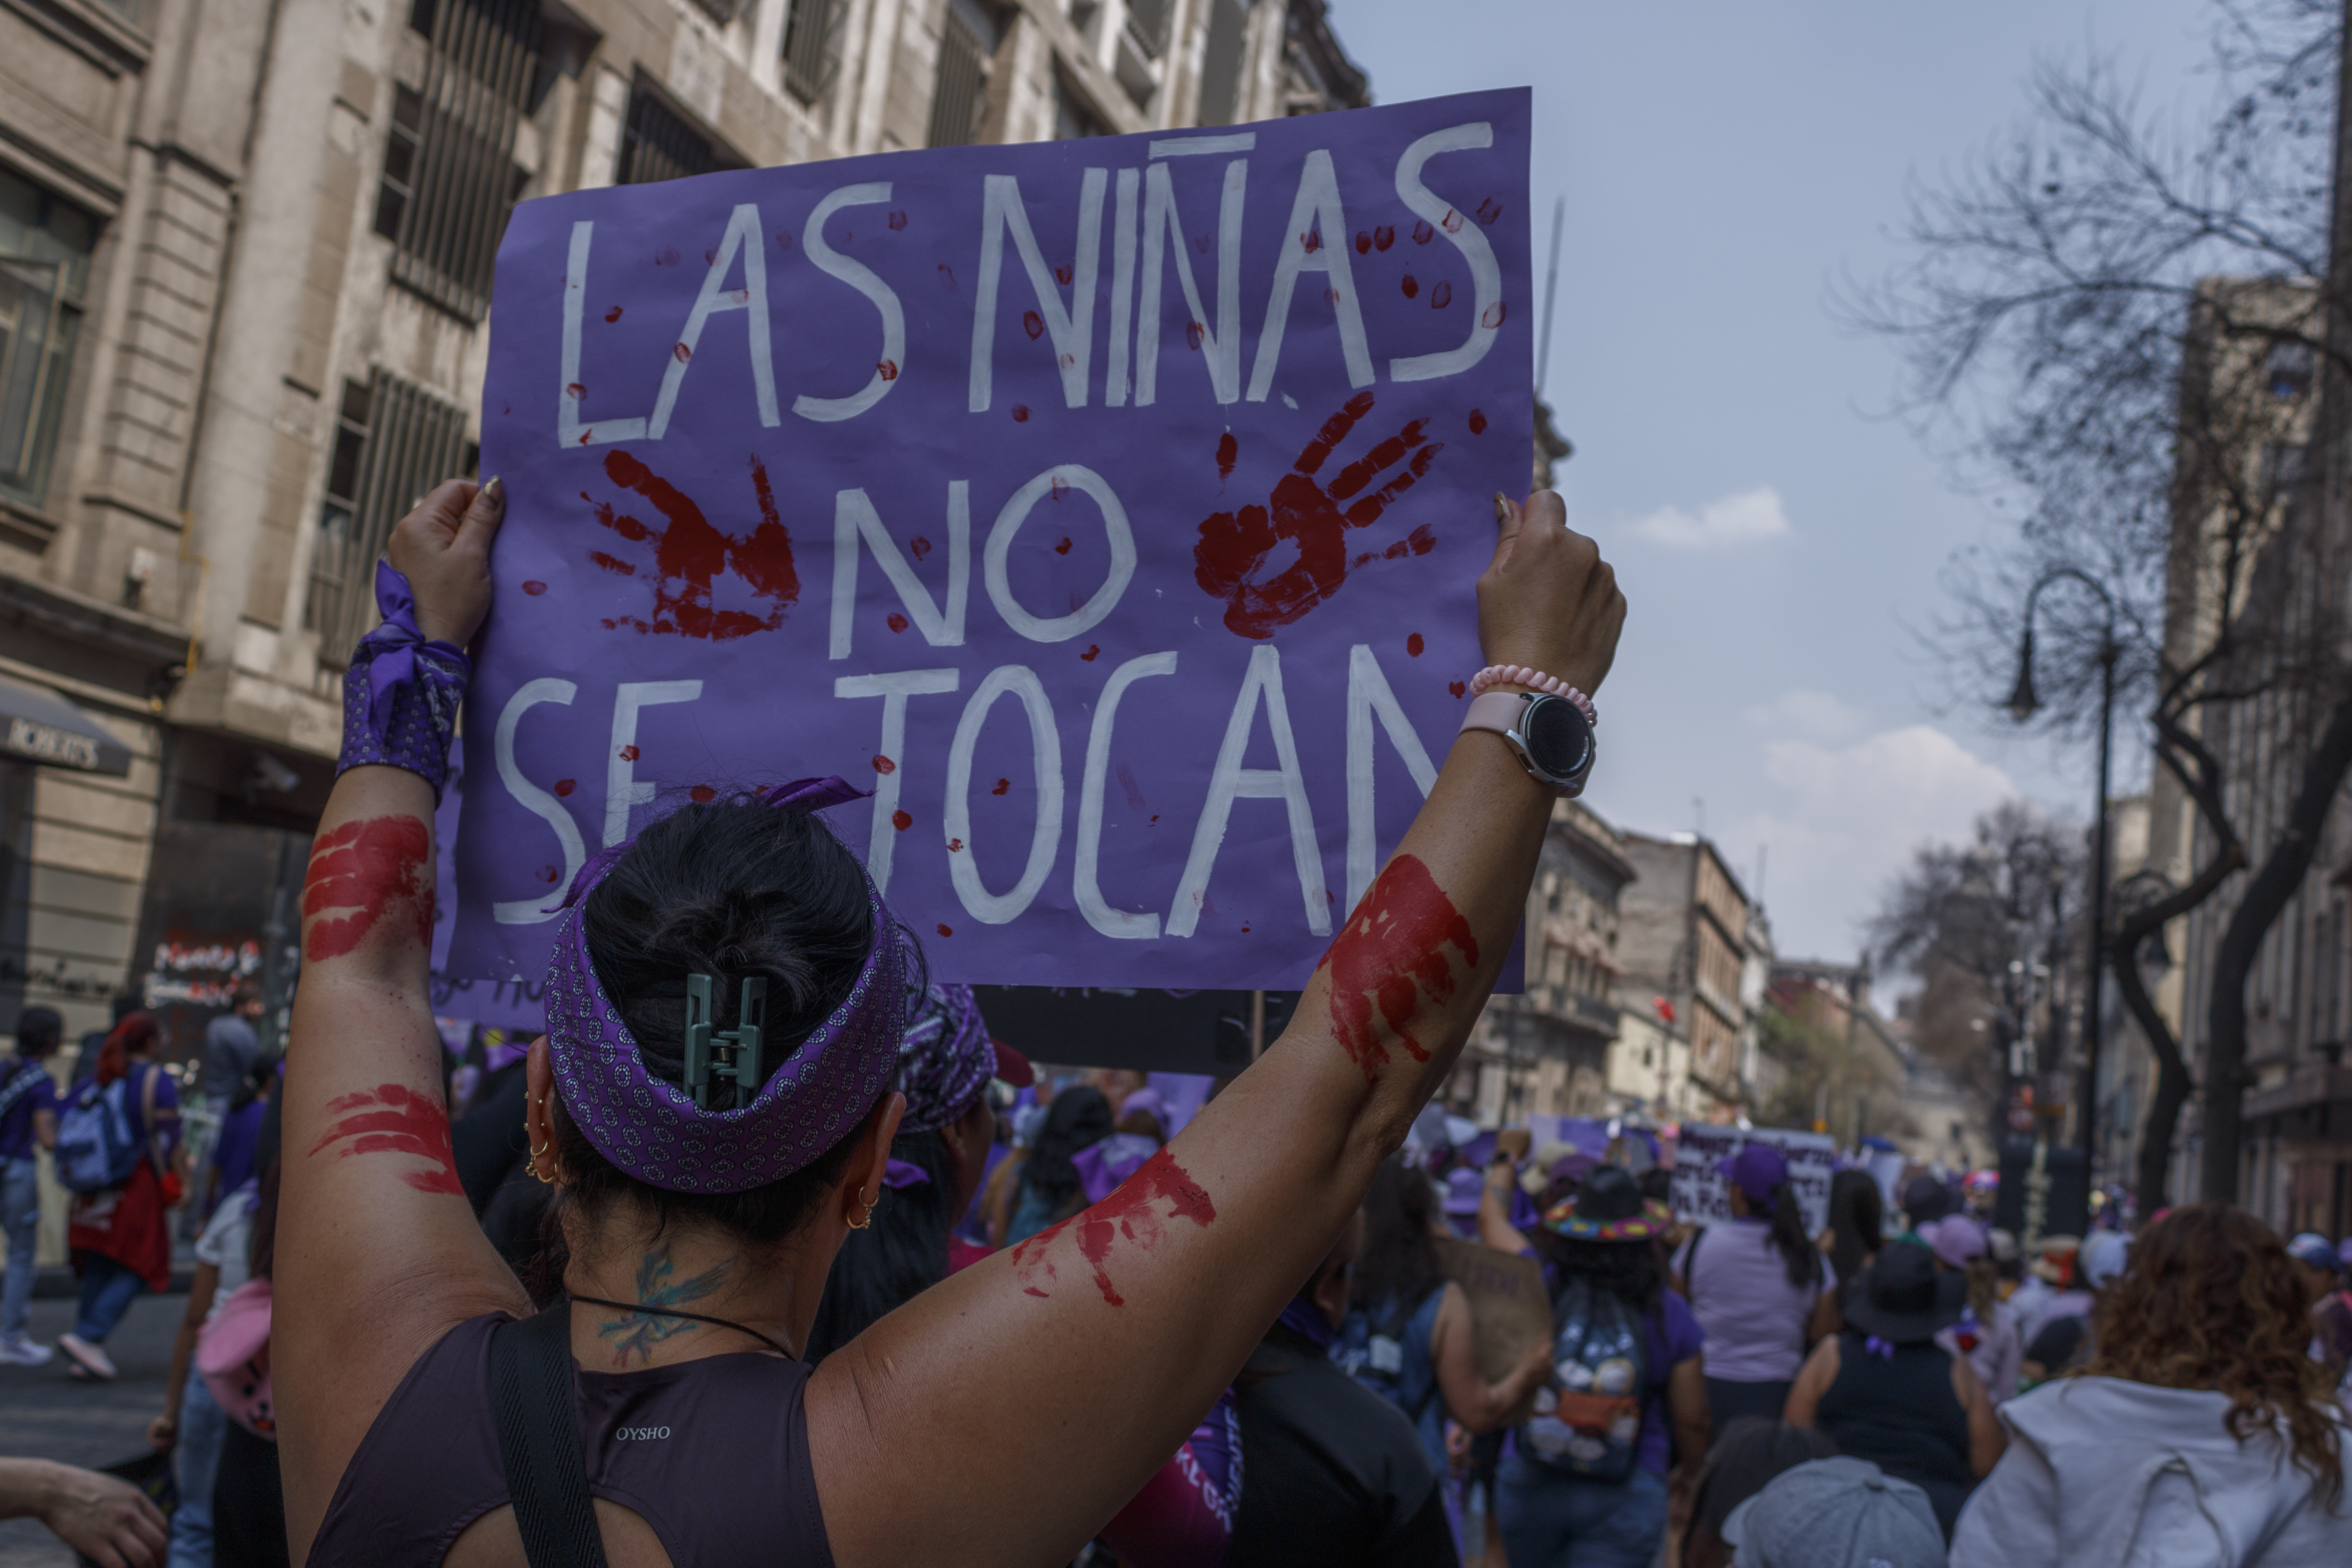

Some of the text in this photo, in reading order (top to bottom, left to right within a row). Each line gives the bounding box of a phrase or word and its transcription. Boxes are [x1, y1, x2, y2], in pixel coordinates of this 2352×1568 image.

[558, 122, 1503, 448] LAS NIÑAS
[828, 463, 1138, 660] NO
[492, 677, 704, 925] SE
[616, 1426, 671, 1441] OYSHO
